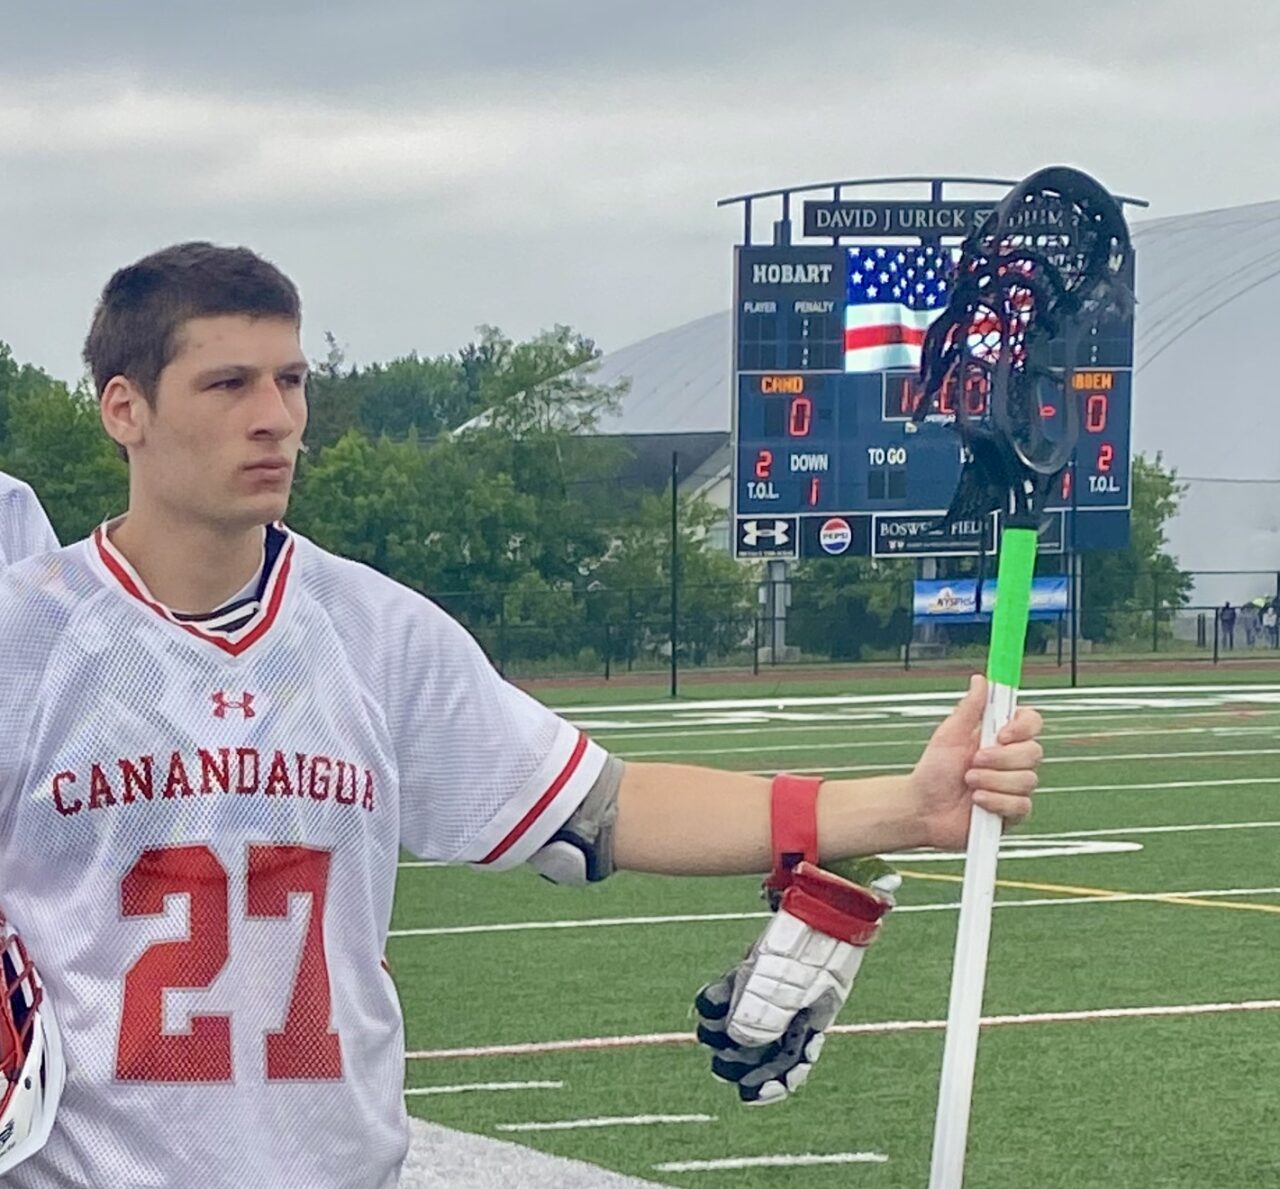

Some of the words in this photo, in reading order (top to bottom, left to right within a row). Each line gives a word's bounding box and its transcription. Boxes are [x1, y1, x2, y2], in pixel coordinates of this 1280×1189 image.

[816, 209, 877, 228] DAVID
[883, 209, 891, 231] J
[899, 208, 966, 228] URICK
[753, 264, 832, 284] HOBART
[744, 301, 777, 313] PLAYER
[794, 301, 835, 313] PENALTY
[790, 398, 812, 436] 0
[1086, 395, 1108, 433] 0
[756, 450, 773, 478] 2
[790, 454, 829, 472] DOWN
[867, 447, 886, 465] TO
[886, 447, 907, 465] GO
[1098, 444, 1113, 472] 2
[747, 482, 780, 500] T.O.L.
[810, 478, 820, 506] 1
[1088, 475, 1121, 493] T.O.L.
[822, 532, 849, 541] PEPSI
[51, 747, 376, 817] CANANDAIGUA
[114, 841, 346, 1086] 27
